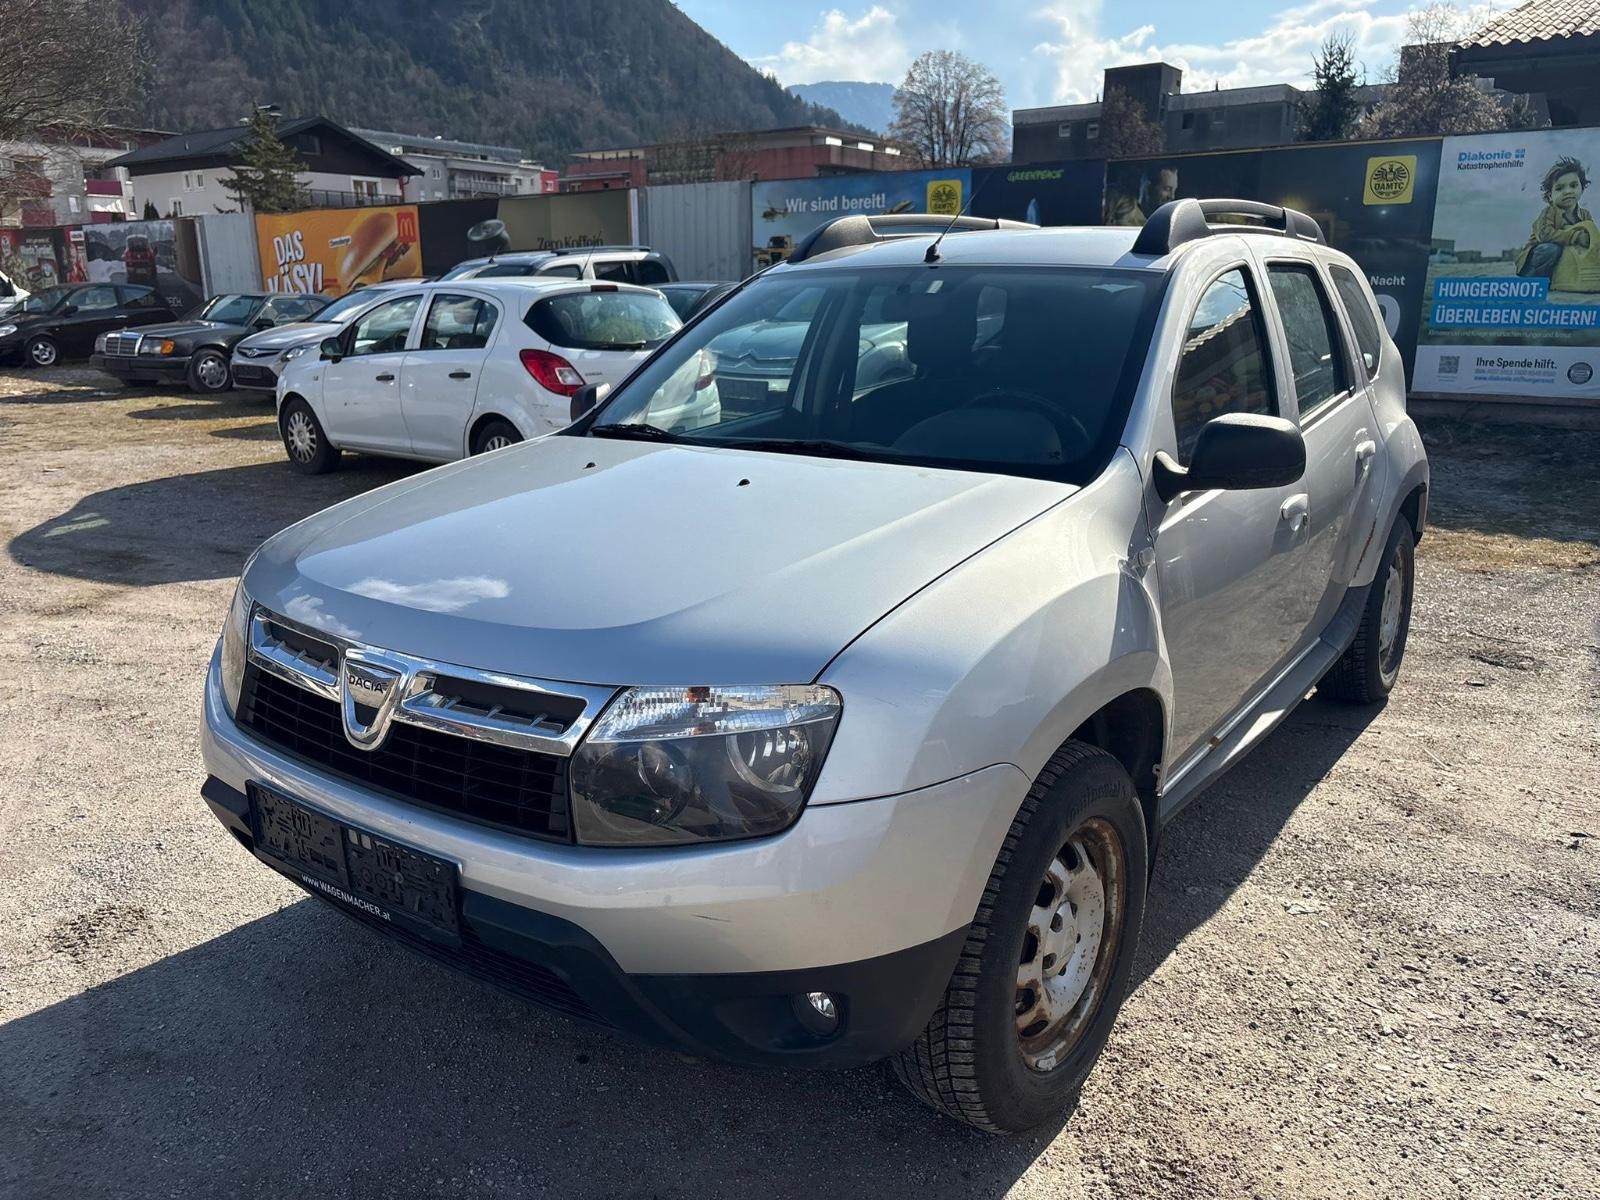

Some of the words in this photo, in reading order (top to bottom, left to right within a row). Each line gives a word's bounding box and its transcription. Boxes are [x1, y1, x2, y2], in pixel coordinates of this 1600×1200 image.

[1457, 150, 1512, 161] Diakonie
[1457, 160, 1524, 170] Katastrophenhilfe
[1007, 169, 1064, 181] GREENPEACE
[785, 197, 807, 212] Wir
[810, 196, 838, 212] sind
[841, 193, 886, 210] bereit!
[273, 230, 304, 267] DAS
[1370, 275, 1406, 286] Nacht
[1438, 281, 1543, 298] HUNGERSNOT:
[1435, 304, 1521, 325] ÜBERLEBEN
[1523, 309, 1597, 327] SICHERN!
[1476, 356, 1495, 367] Ihre
[1497, 357, 1533, 369] Spende
[1534, 358, 1558, 370] hilft.
[348, 673, 384, 694] DACIA
[301, 873, 391, 921] www.WAGENMACHER.at
